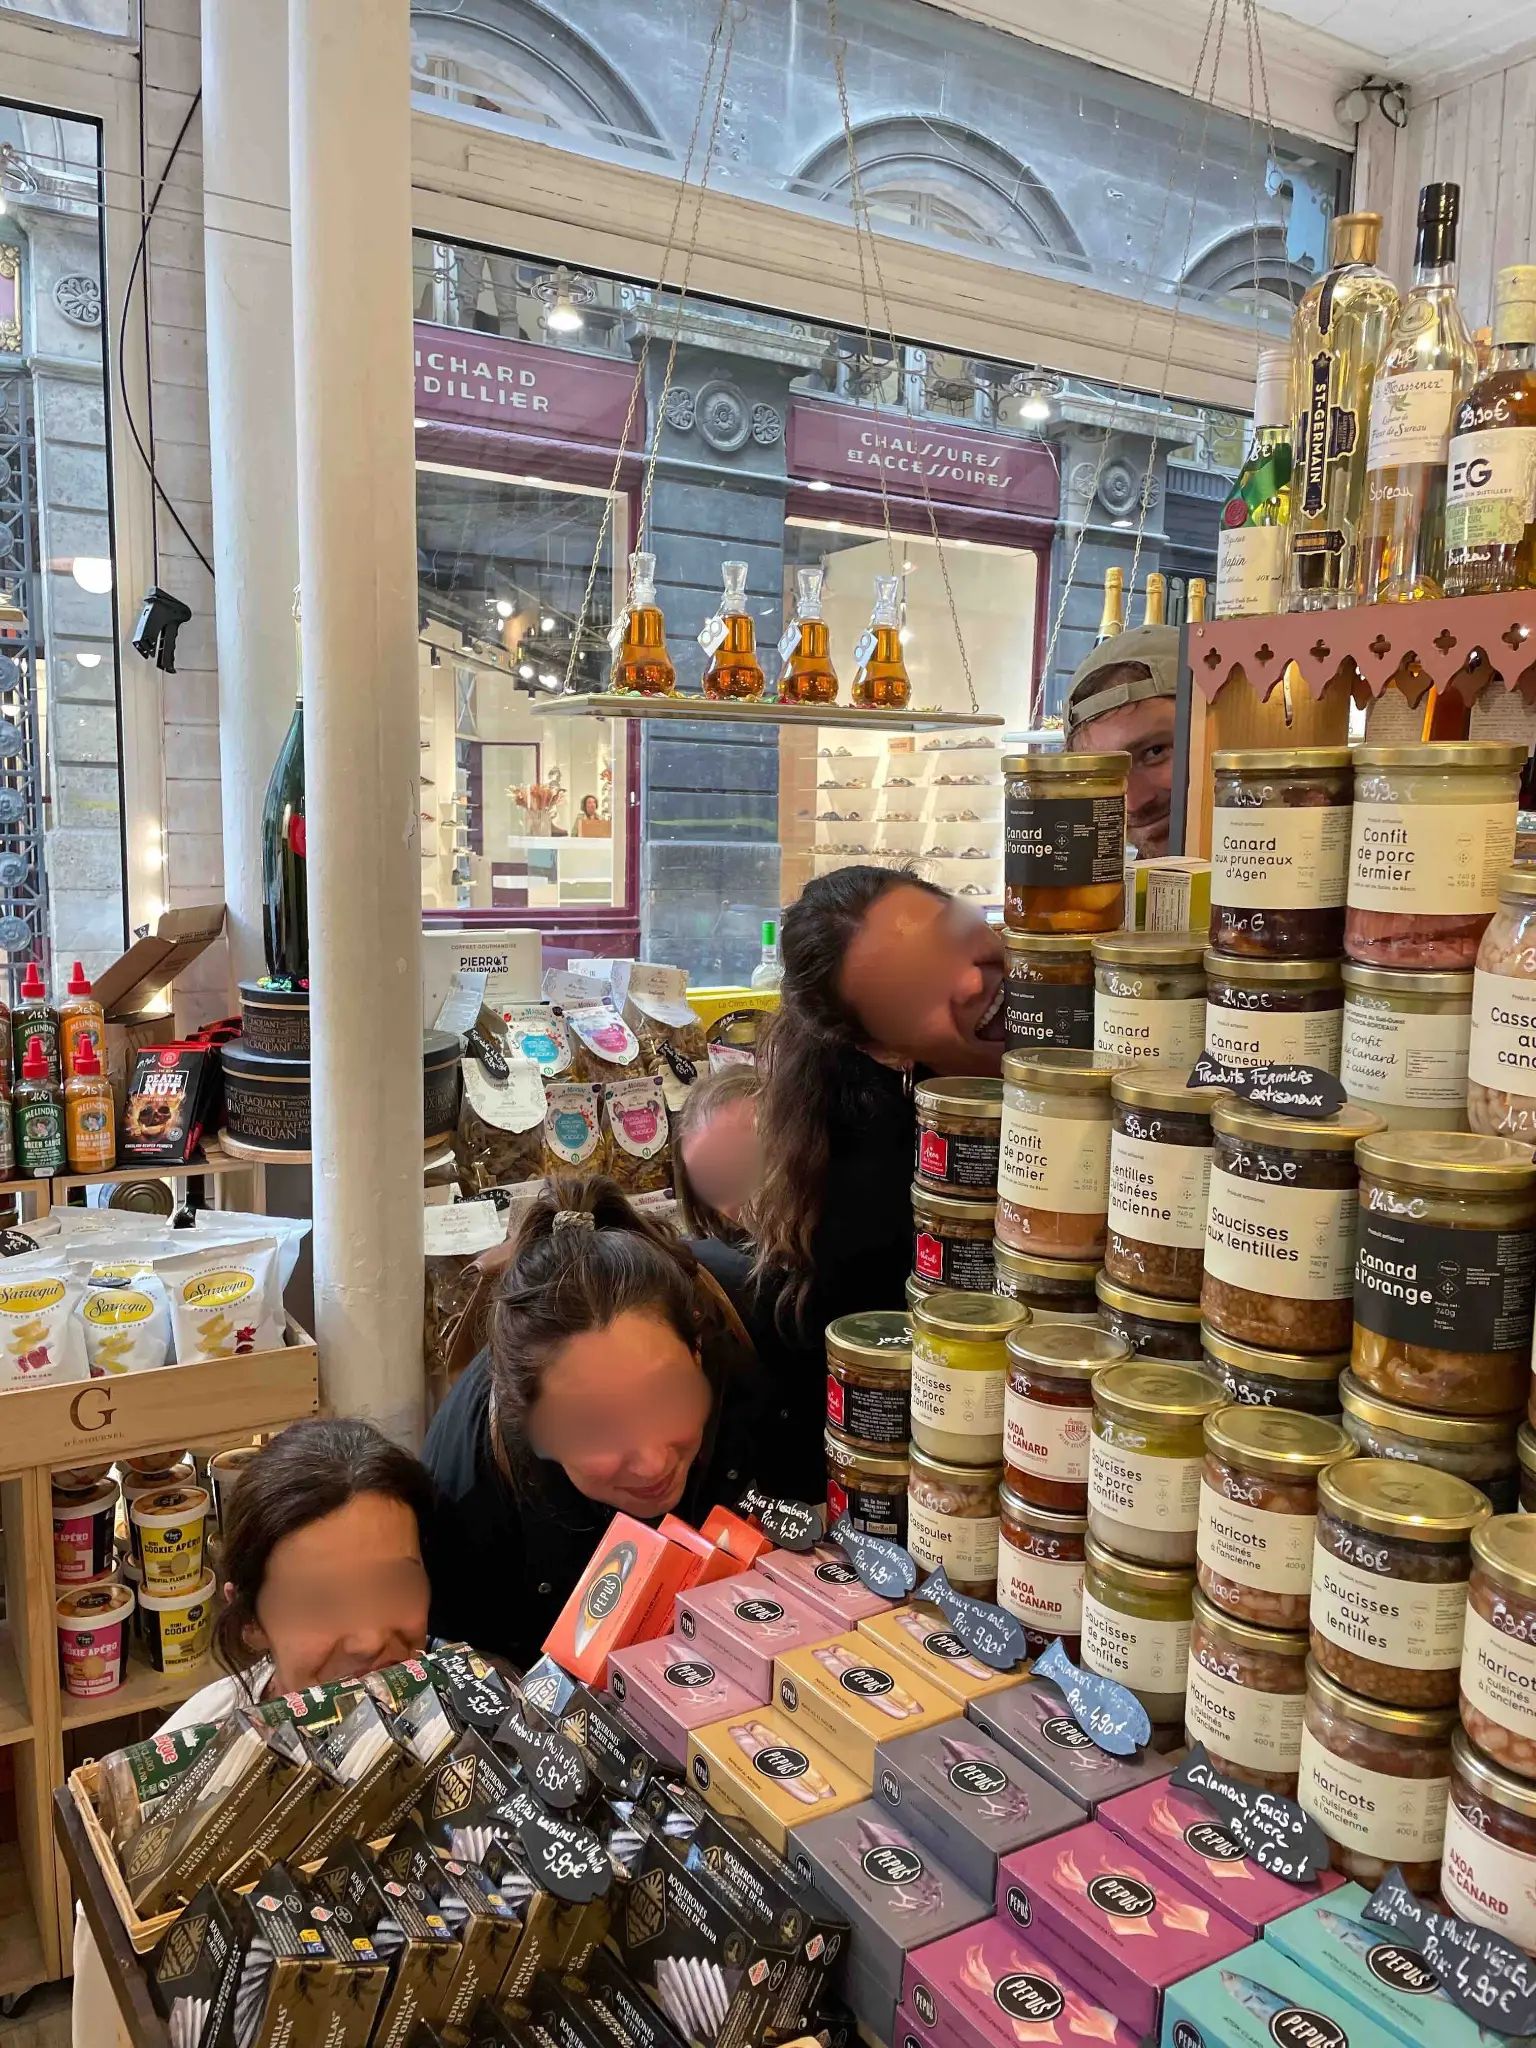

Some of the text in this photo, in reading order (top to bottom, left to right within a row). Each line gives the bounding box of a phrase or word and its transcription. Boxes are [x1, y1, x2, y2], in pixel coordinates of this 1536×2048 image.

[414, 375, 549, 412] DILLIER
[1310, 383, 1327, 484] ST-GERMAIN
[861, 432, 1001, 467] CHAUSSURES
[847, 449, 1013, 488] ET ACCESSOIRES
[1452, 458, 1493, 491] EG
[1006, 827, 1042, 840] Canard
[1223, 836, 1276, 851] Canard
[1363, 827, 1408, 844] Confit
[1230, 853, 1293, 866] pruneaux
[1357, 846, 1415, 864] de porc
[1225, 868, 1267, 882] d'Agen
[1357, 863, 1411, 881] fermier
[460, 955, 508, 967] PIERROT
[1006, 1006, 1044, 1022] Canard
[1008, 1023, 1054, 1039] l'orange
[1103, 1021, 1150, 1038] Canard
[1351, 1032, 1383, 1048] Confit
[1117, 1041, 1160, 1058] cèpes
[1211, 1033, 1260, 1053] Canard
[1352, 1048, 1399, 1065] Canard
[146, 1073, 183, 1084] DEATH
[1351, 1064, 1389, 1079] cuisses
[143, 1082, 181, 1096] NUT
[1008, 1130, 1042, 1149] Confit
[1017, 1153, 1048, 1168] porc
[1212, 1206, 1289, 1241] Saucisses
[1208, 1223, 1299, 1262] aux lentilles
[1359, 1247, 1418, 1280] Canard
[1354, 1261, 1433, 1306] à l'orange
[228, 1295, 251, 1309] CHIPS
[1435, 1307, 1456, 1318] 740g
[922, 1387, 945, 1404] porc
[69, 1387, 118, 1432] G
[1012, 1434, 1048, 1457] CANARD
[1091, 1448, 1143, 1482] Saucisses
[1106, 1477, 1134, 1494] porc
[909, 1513, 953, 1543] Cassoulet
[1210, 1515, 1267, 1549] Haricots
[144, 1544, 173, 1554] COOKIE
[911, 1541, 943, 1565] canard
[919, 1536, 932, 1548] au
[1217, 1538, 1252, 1558] cuisinés
[1216, 1549, 1261, 1570] l'ancienne
[823, 1564, 853, 1583] PEPUS
[593, 1579, 618, 1613] PEPUS
[1010, 1577, 1035, 1596] AXOA
[1324, 1575, 1400, 1617] Saucisses
[744, 1602, 773, 1620] PEPUS
[1018, 1593, 1062, 1613] CANARD
[1085, 1606, 1138, 1644] Saucisses
[1340, 1607, 1370, 1627] aux
[164, 1624, 196, 1636] COOKIE
[1088, 1626, 1129, 1656] de porc
[1327, 1611, 1388, 1649] lentilles
[88, 1641, 118, 1657] APÉRO
[932, 1635, 968, 1656] PEPUS
[1086, 1638, 1129, 1670] confites
[674, 1664, 706, 1685] PEPUS
[851, 1671, 885, 1693] PEPUS
[782, 1685, 796, 1706] PEPUS
[1190, 1682, 1236, 1722] Haricots
[1487, 1676, 1530, 1704] cuisinés
[589, 1712, 620, 1746] BOQUERONES
[1050, 1721, 1088, 1745] PEPUS
[363, 1753, 398, 1794] ANDALUCÍA
[694, 1761, 708, 1784] PEPUS
[764, 1750, 798, 1775] PEPUS
[441, 1768, 467, 1807] USISA
[883, 1776, 899, 1798] PEPUS
[958, 1765, 1000, 1791] PEPUS
[1313, 1767, 1376, 1812] Haricots
[175, 1846, 202, 1876] FILETES
[204, 1805, 235, 1840] CABALLA
[238, 1755, 274, 1799] ANDALUCÍA
[252, 1776, 317, 1850] ABALLA ANDALUCÍA
[1319, 1800, 1369, 1834] l'ancienne
[1321, 1794, 1359, 1820] cuisinés
[218, 1811, 238, 1835] OLIVA
[1194, 1827, 1239, 1857] PEPUS
[724, 1851, 765, 1896] BOQUERONES
[873, 1850, 914, 1880] PEPUS
[668, 1873, 708, 1920] BOQUERONES
[730, 1871, 774, 1921] ACEITE OLIVA
[1010, 1892, 1029, 1920] PEPUS
[1098, 1880, 1146, 1914] PEPUS
[1388, 1885, 1422, 1924] Thon
[1456, 1873, 1509, 1916] CANARD
[674, 1895, 717, 1945] ACEITE DE OLIVA
[1378, 1950, 1431, 1987] PEPUS
[1422, 1935, 1453, 1978] Prix:
[1007, 1979, 1053, 2017] PEPUS
[616, 1991, 655, 2041] BOQUERONES
